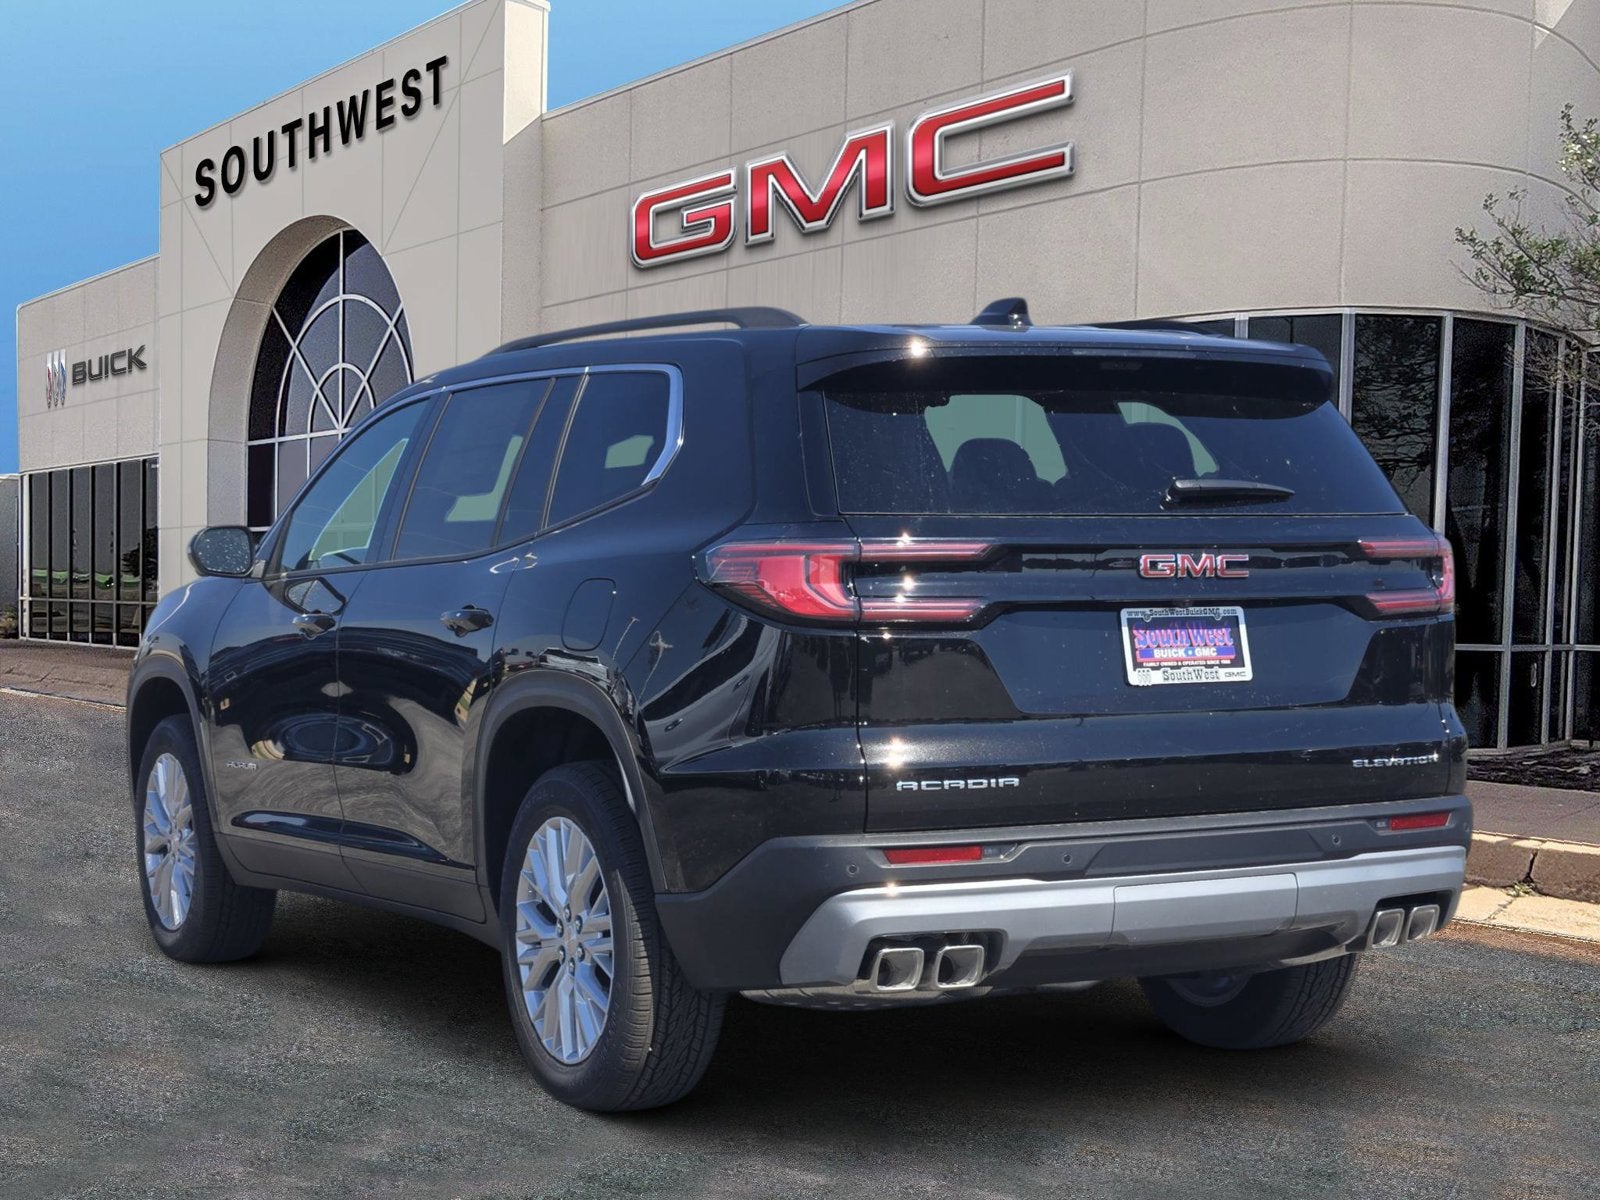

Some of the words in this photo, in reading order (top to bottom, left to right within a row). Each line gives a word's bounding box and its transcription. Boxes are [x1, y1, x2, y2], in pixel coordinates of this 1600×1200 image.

[194, 56, 449, 207] SOUTHWEST
[631, 70, 1075, 268] GMC
[72, 345, 147, 386] BUICK
[1139, 553, 1250, 578] GMC
[1153, 648, 1185, 659] BUICK
[1194, 646, 1218, 657] GMC
[1352, 754, 1440, 768] ELEVATION
[896, 777, 1020, 791] ACADIA
